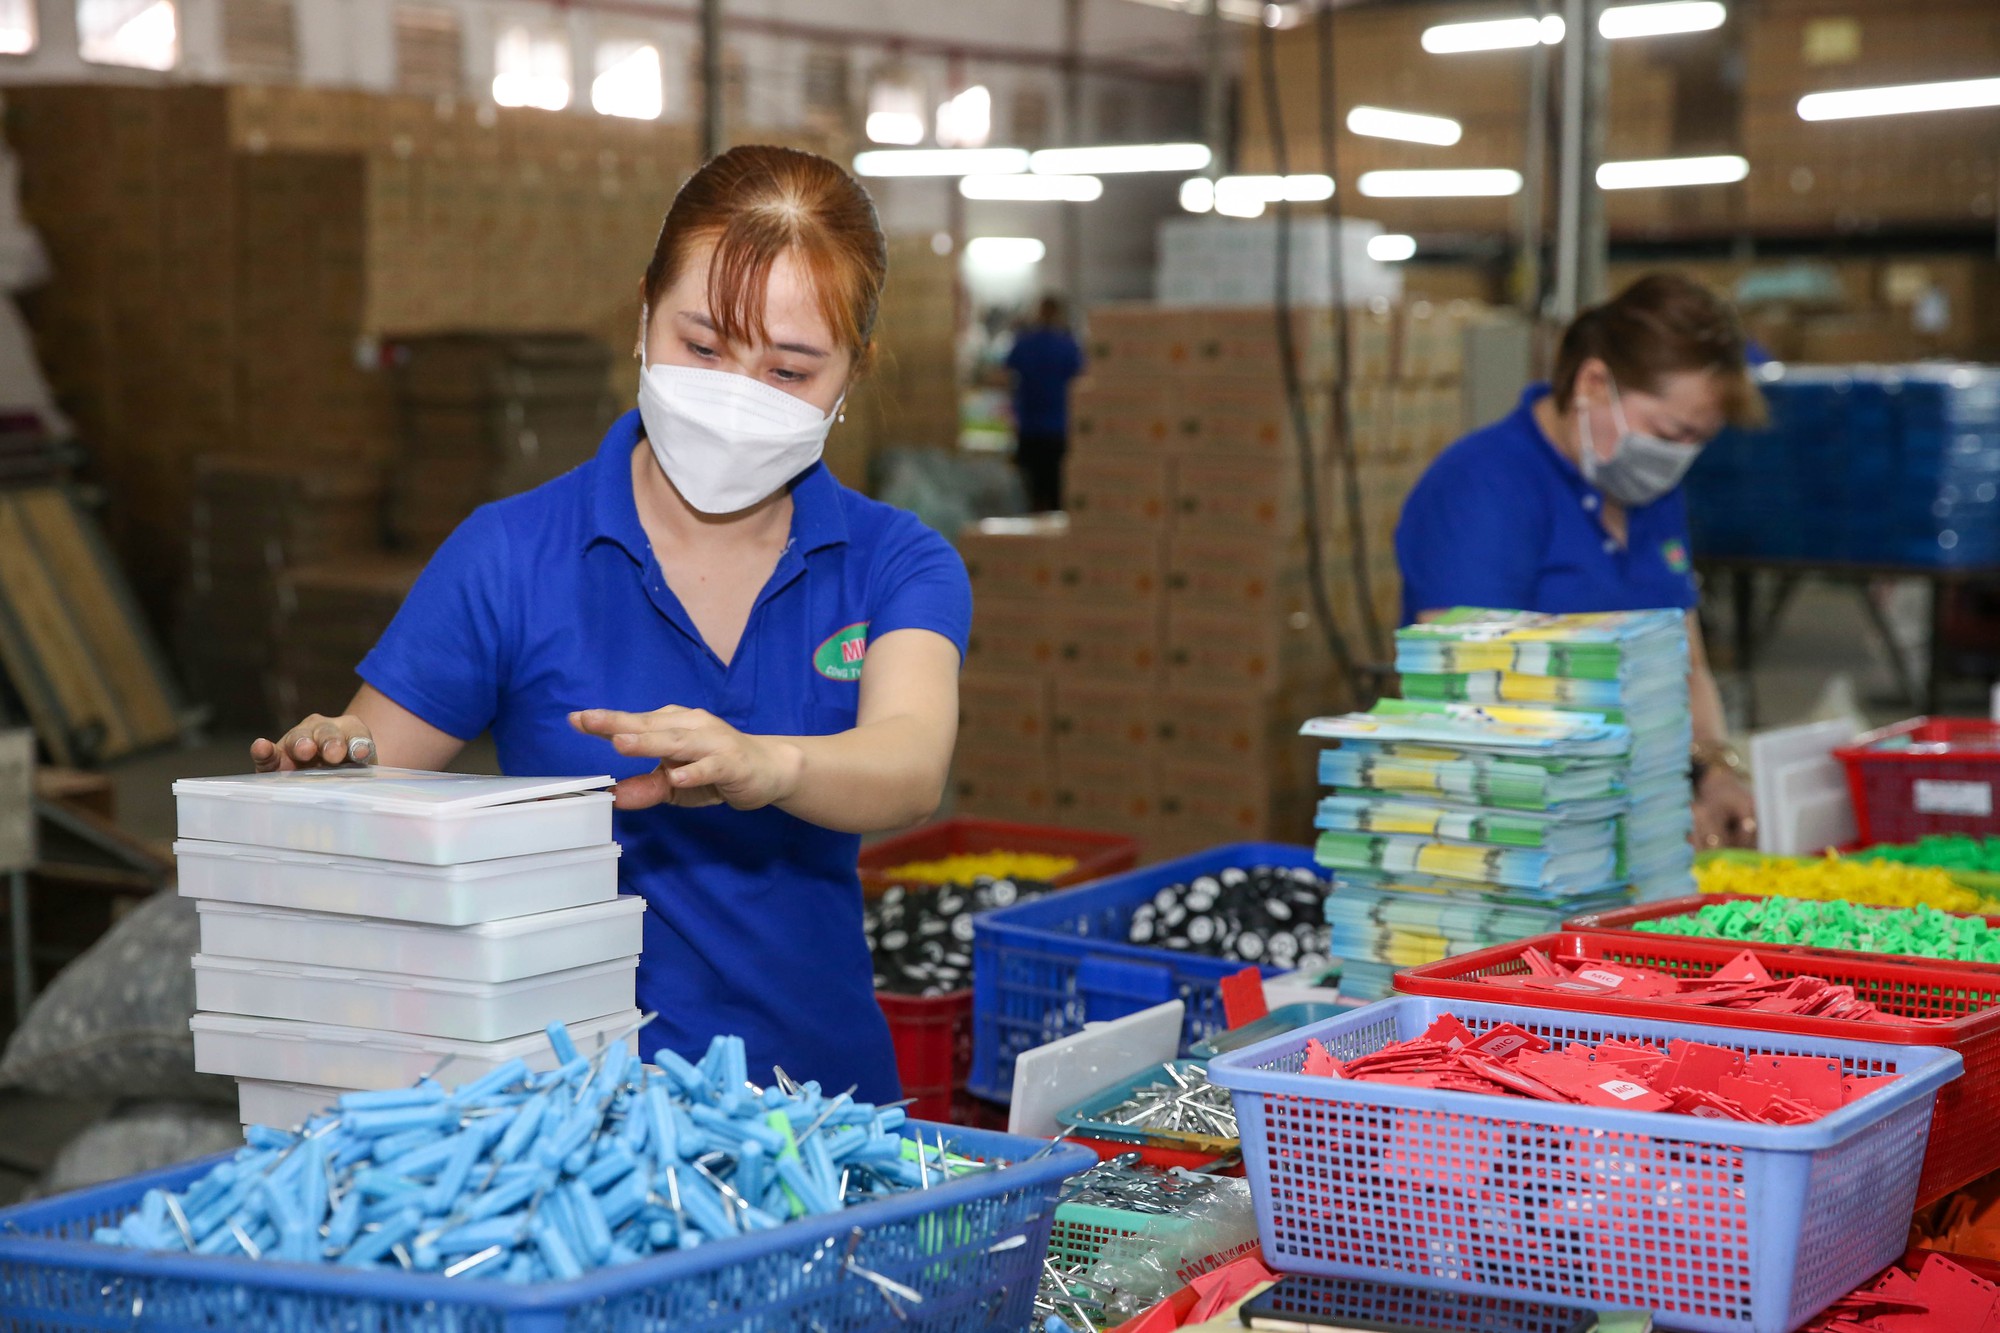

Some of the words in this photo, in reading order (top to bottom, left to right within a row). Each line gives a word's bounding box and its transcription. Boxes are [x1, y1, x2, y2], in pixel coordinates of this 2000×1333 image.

[842, 639, 867, 662] MI
[1591, 973, 1615, 982] MIC
[1491, 1038, 1514, 1051] MIC
[1612, 1084, 1633, 1095] MIC
